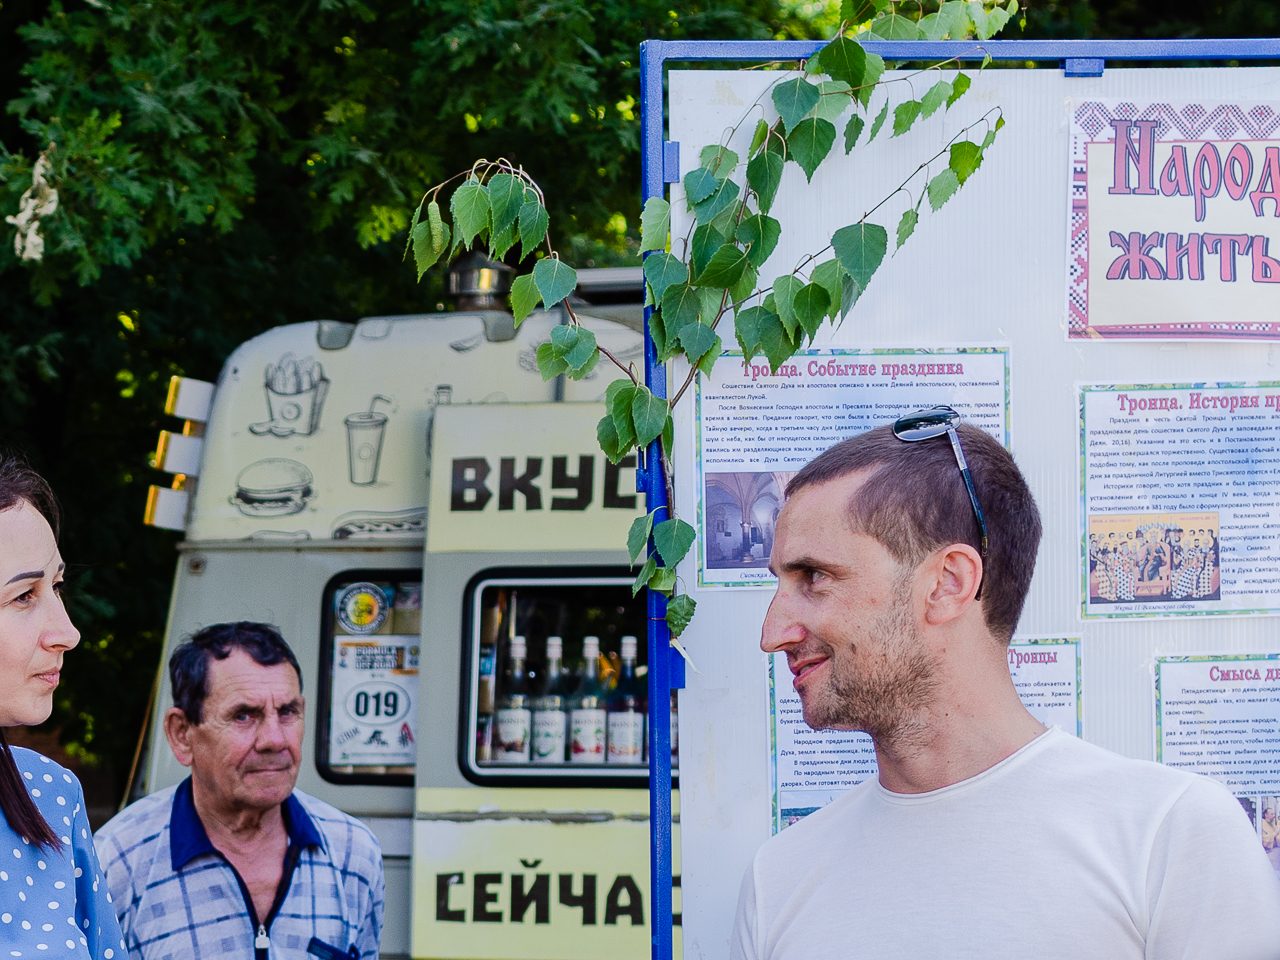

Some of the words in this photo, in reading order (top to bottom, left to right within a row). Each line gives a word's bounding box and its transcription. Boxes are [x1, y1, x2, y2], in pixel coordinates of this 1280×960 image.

[807, 357, 877, 377] Событие
[881, 361, 964, 380] праздника
[1117, 394, 1183, 415] Троица.
[1189, 393, 1259, 413] История
[1112, 471, 1153, 479] праздничной
[355, 691, 398, 717] 019
[794, 727, 812, 735] Цветы
